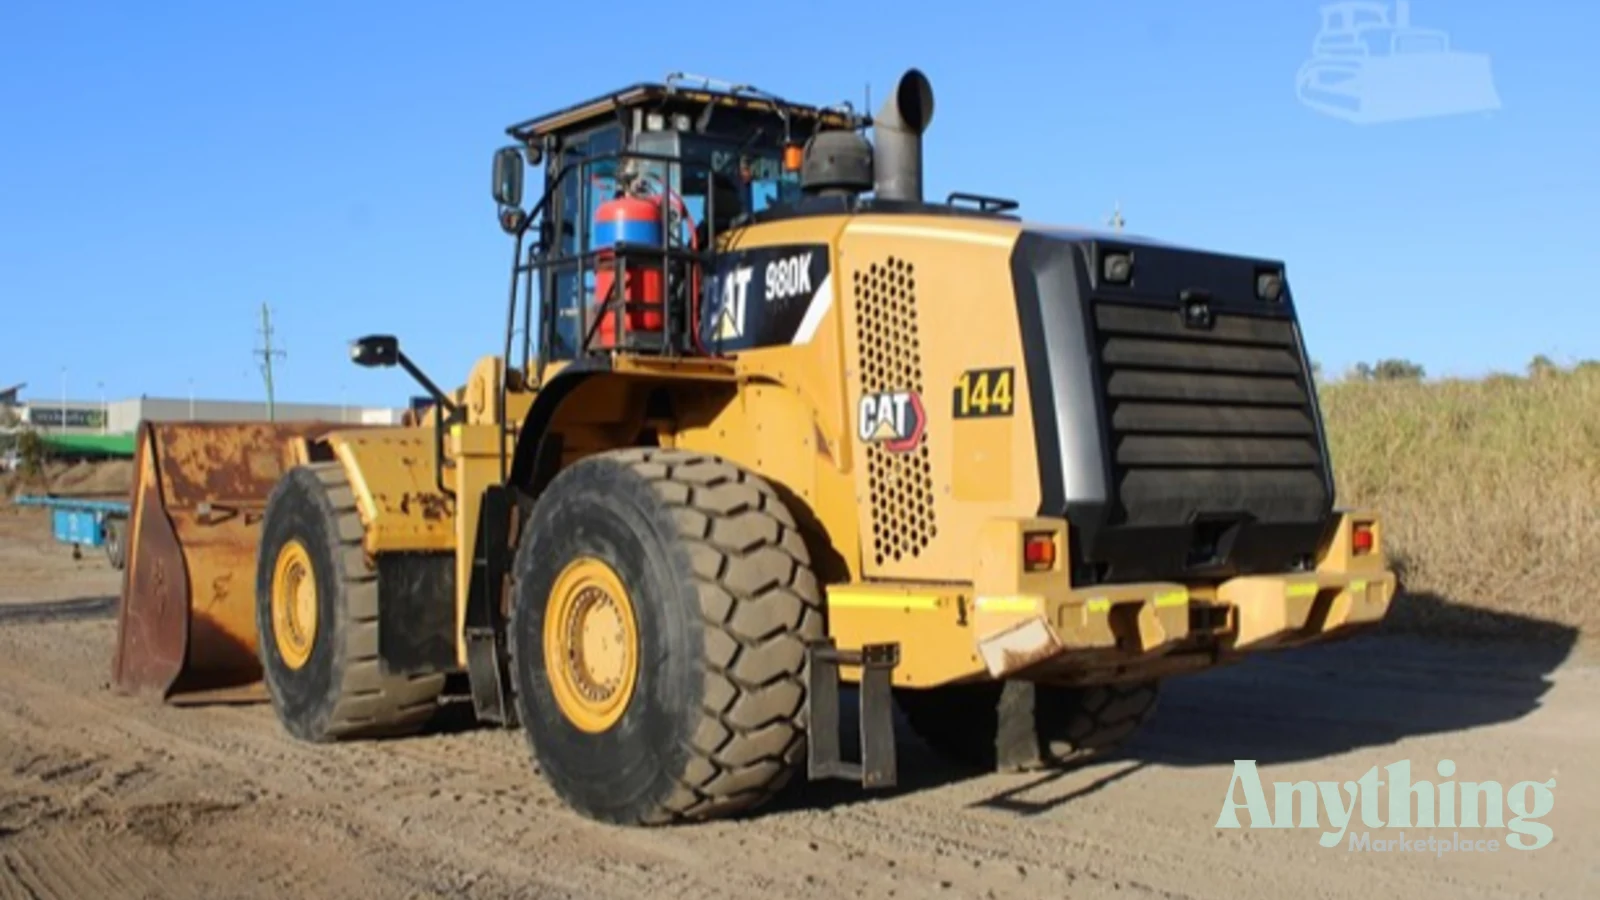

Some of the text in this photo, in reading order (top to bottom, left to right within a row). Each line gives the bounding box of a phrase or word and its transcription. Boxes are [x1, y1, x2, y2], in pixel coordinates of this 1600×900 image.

[765, 252, 812, 300] 980K
[860, 393, 909, 441] CAT
[959, 371, 1011, 415] 144
